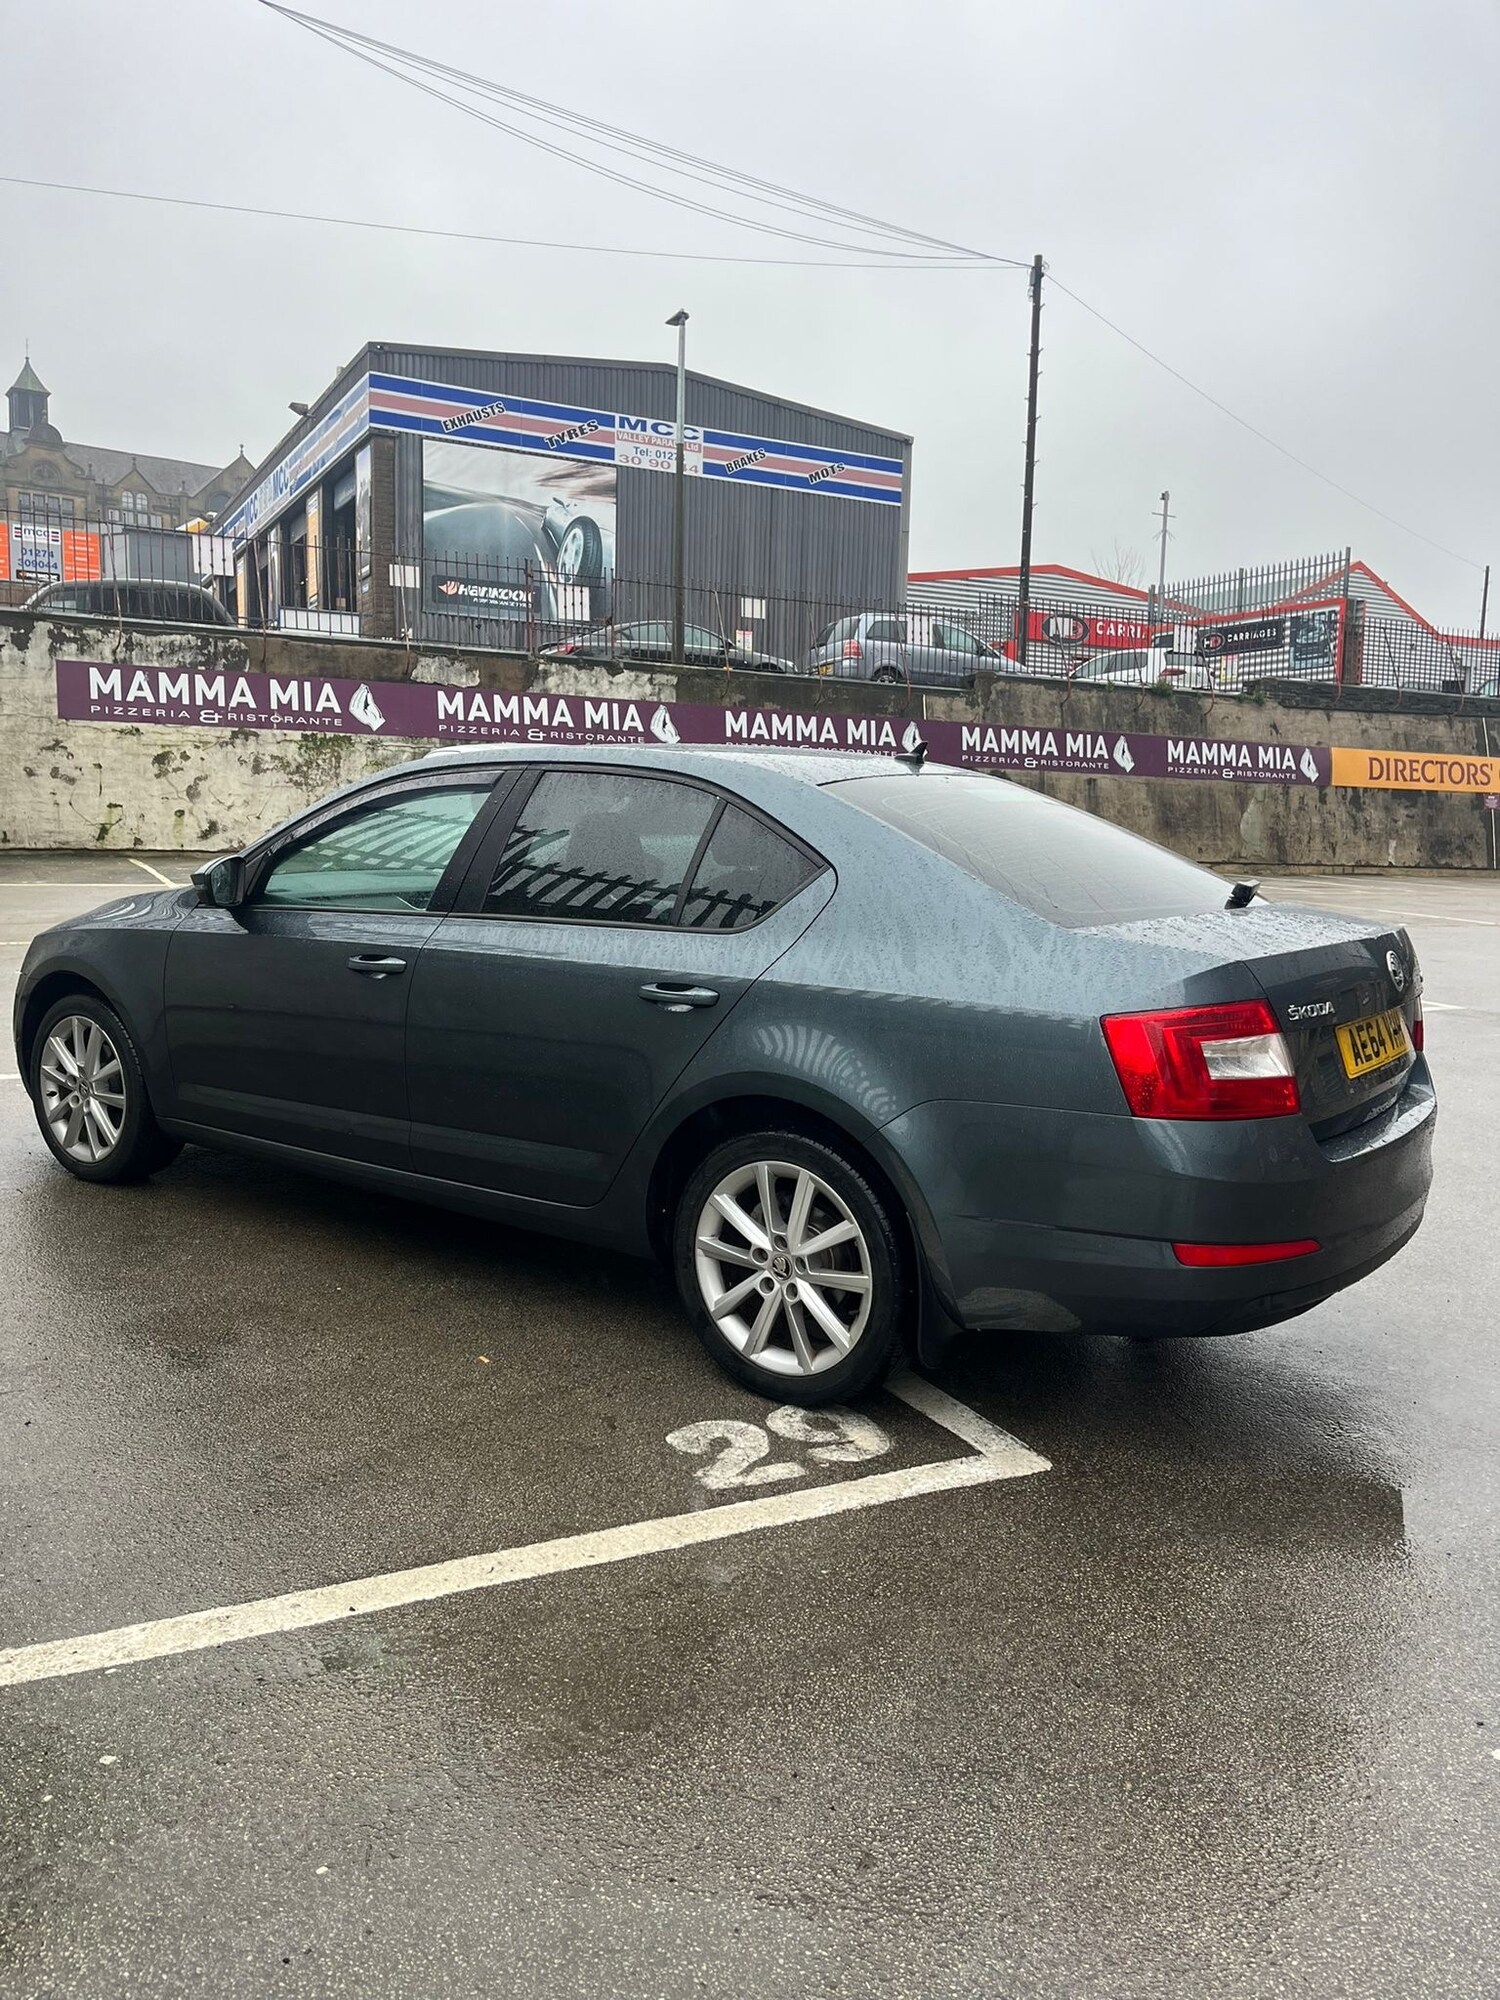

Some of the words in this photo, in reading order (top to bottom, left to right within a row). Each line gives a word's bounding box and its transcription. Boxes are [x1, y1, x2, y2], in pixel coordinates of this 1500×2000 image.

[442, 402, 506, 432] EXHAUSTS
[618, 415, 700, 440] MCC
[545, 420, 600, 449] TYRES
[617, 431, 650, 444] VALLEY
[651, 437, 678, 448] PARAD
[619, 454, 642, 465] 30
[648, 458, 671, 470] 90
[633, 446, 652, 457] Tel:
[655, 450, 678, 460] 0127
[725, 448, 767, 474] BRAKES
[1096, 621, 1147, 639] CARRI
[88, 666, 257, 709] MAMMA
[269, 678, 342, 714] MIA
[90, 705, 191, 719] PIZZERIA
[199, 709, 222, 724] &
[227, 712, 343, 727] RISTORANTE
[436, 690, 575, 728] MAMMA
[584, 700, 645, 733] MIA
[438, 724, 521, 737] PIZZERIA
[527, 728, 547, 741] &
[550, 731, 646, 744] RISTORANTE
[724, 710, 839, 744] MAMMA
[847, 718, 897, 747] MIA
[961, 725, 1059, 757] MAMMA
[1066, 732, 1109, 760] MIA
[1167, 739, 1253, 768] MAMMA
[1258, 745, 1297, 770] MIA
[961, 754, 1020, 765] PIZZERIA
[1023, 757, 1039, 768] &
[1040, 759, 1110, 770] RISTORANTE
[1167, 766, 1219, 776] PIZZERIA
[1222, 768, 1235, 779] &
[1236, 770, 1297, 780] RISTORANTE
[1368, 756, 1493, 786] DIRECTORS'
[1287, 1001, 1336, 1021] ŠKODA
[1348, 1018, 1388, 1067] AE64
[664, 1404, 890, 1490] 29
